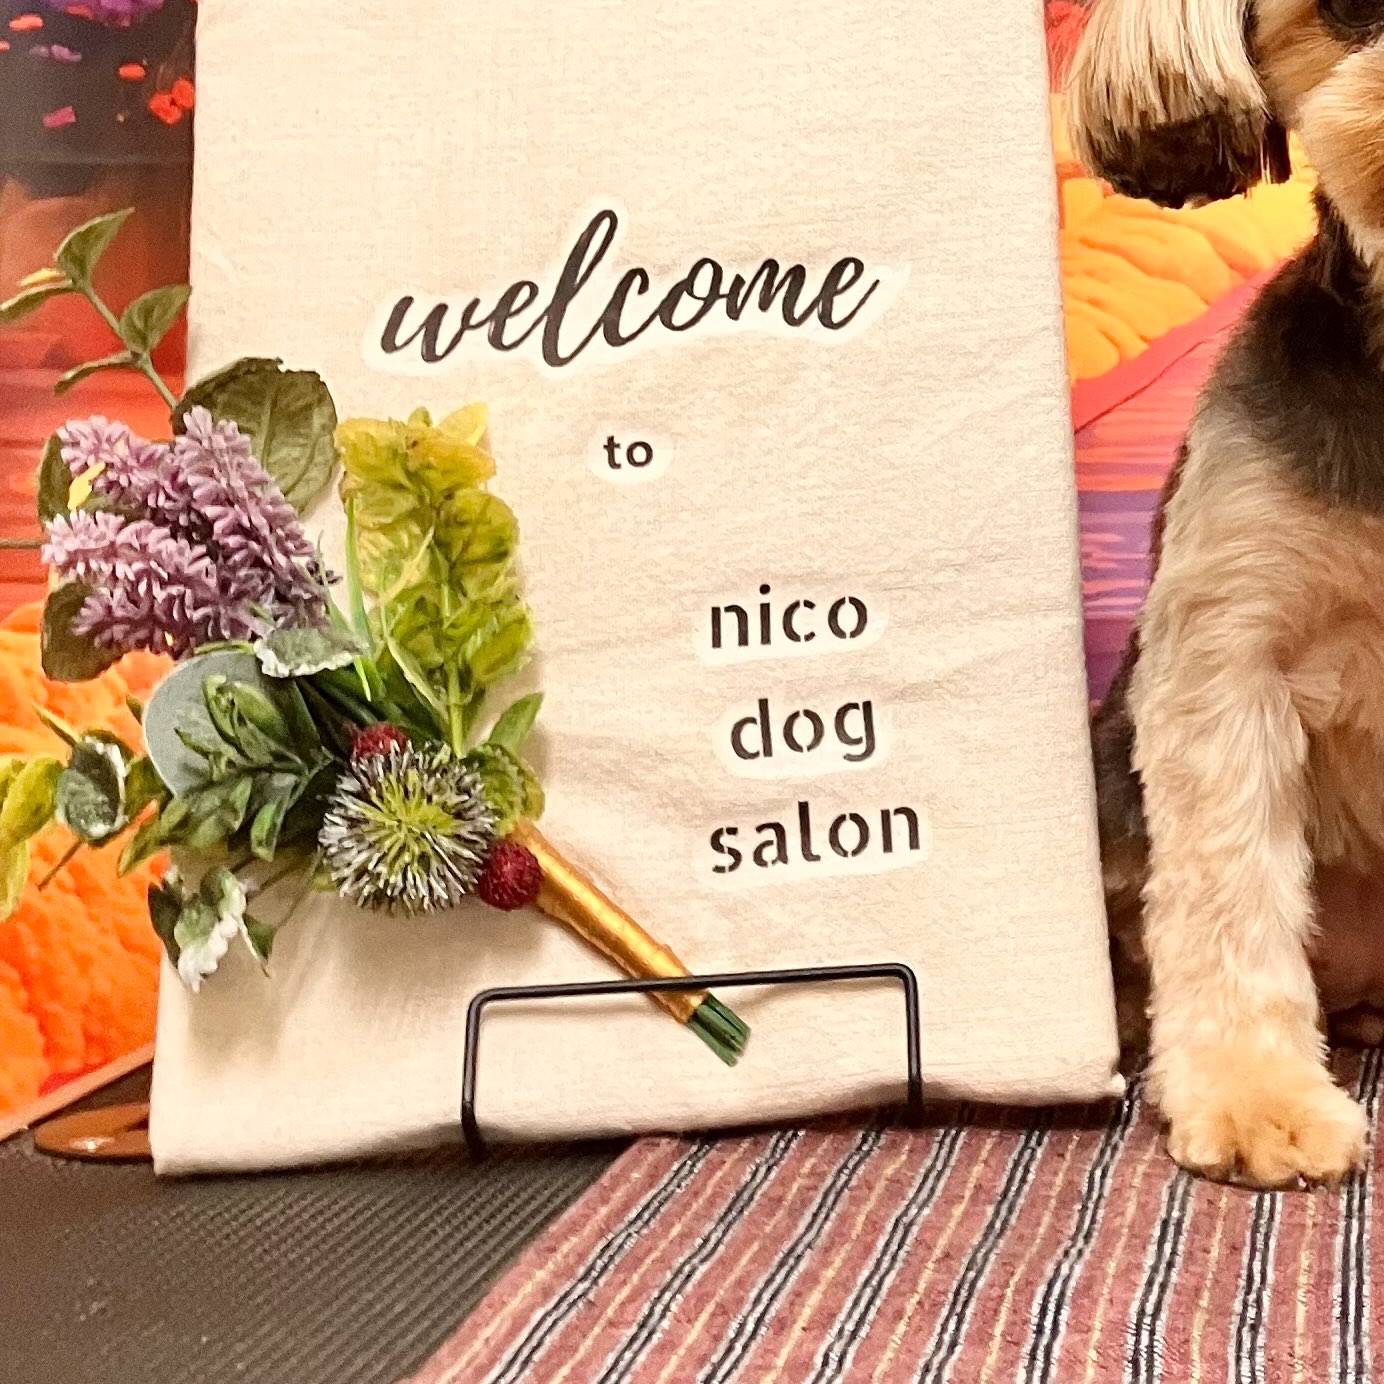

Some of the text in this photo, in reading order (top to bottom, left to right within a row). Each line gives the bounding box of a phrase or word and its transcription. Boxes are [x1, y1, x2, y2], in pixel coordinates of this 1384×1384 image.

[380, 209, 880, 367] welcome
[603, 435, 653, 469] to
[711, 583, 868, 648] nico
[730, 698, 876, 762] dog
[710, 801, 920, 873] salon
